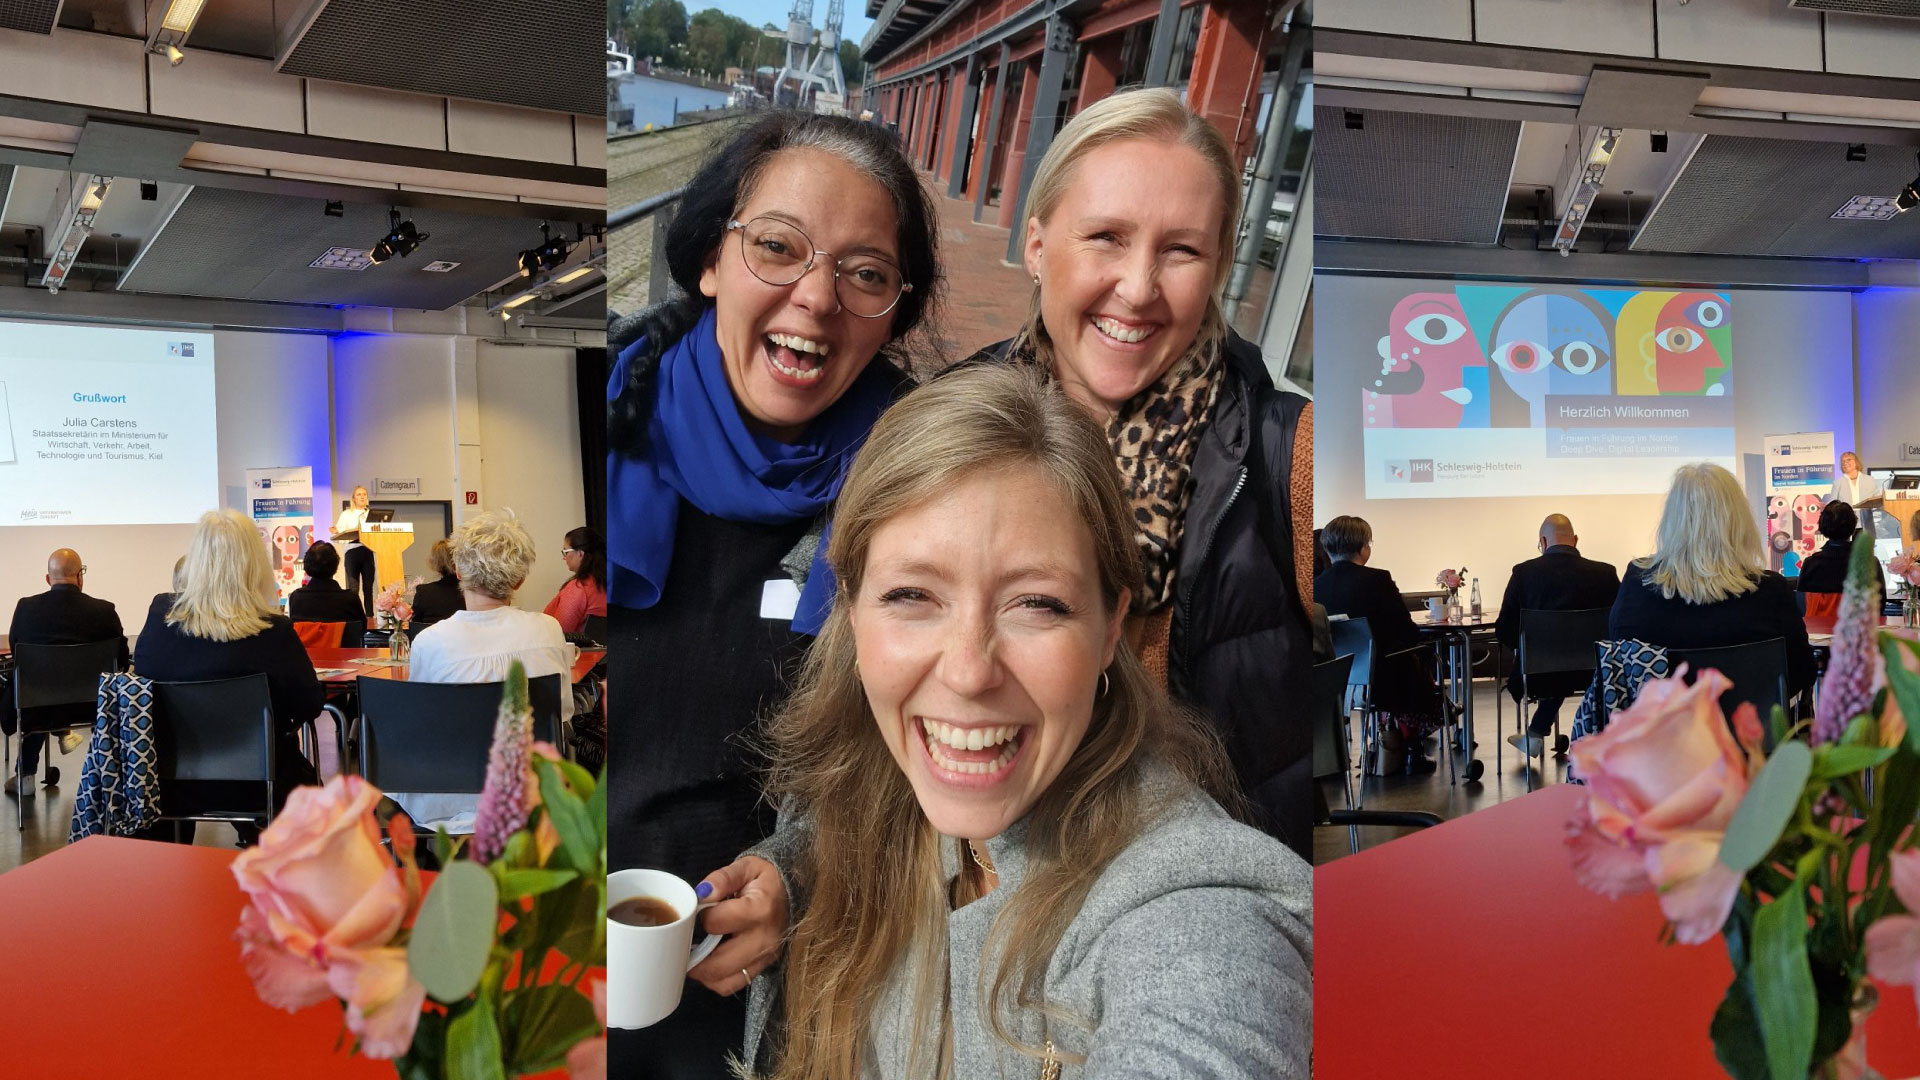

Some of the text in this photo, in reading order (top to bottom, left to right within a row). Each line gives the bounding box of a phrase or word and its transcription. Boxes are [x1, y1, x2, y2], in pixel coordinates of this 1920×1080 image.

[73, 392, 127, 403] Grußwort
[1559, 405, 1689, 418] Herzlich Willkommen
[62, 417, 137, 428] Julia Carstens
[32, 429, 98, 438] Staatssekretärin
[111, 431, 156, 439] Ministerium
[158, 431, 169, 440] für
[36, 451, 86, 461] Technologie
[148, 452, 163, 460] Kiel
[1412, 461, 1523, 474] IHK Schleswig-Holstein
